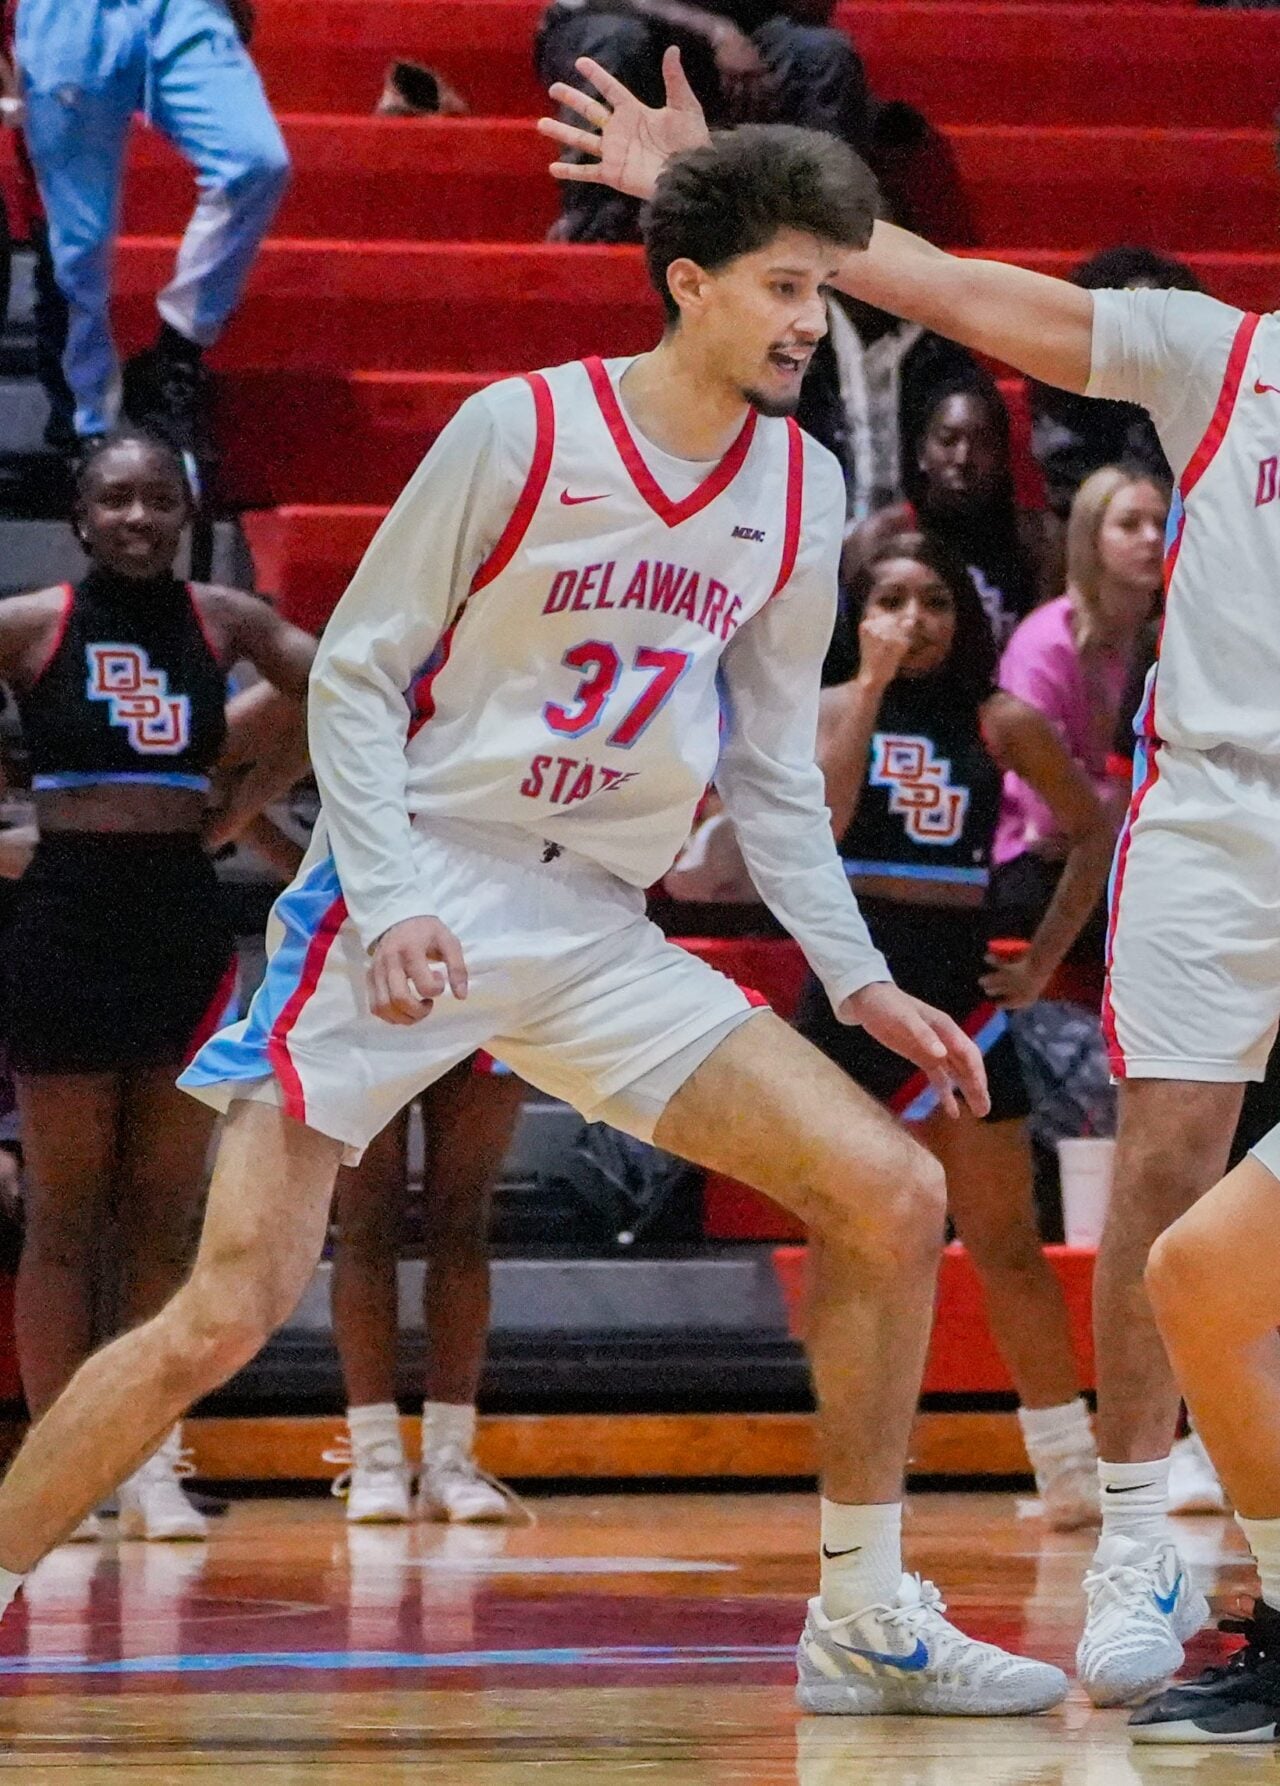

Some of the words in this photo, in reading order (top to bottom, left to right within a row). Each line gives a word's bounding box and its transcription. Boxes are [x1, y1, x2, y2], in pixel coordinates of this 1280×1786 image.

[542, 559, 744, 642] DELAWARE
[87, 644, 190, 754] DSU
[540, 638, 695, 750] 37
[870, 735, 969, 846] DSU
